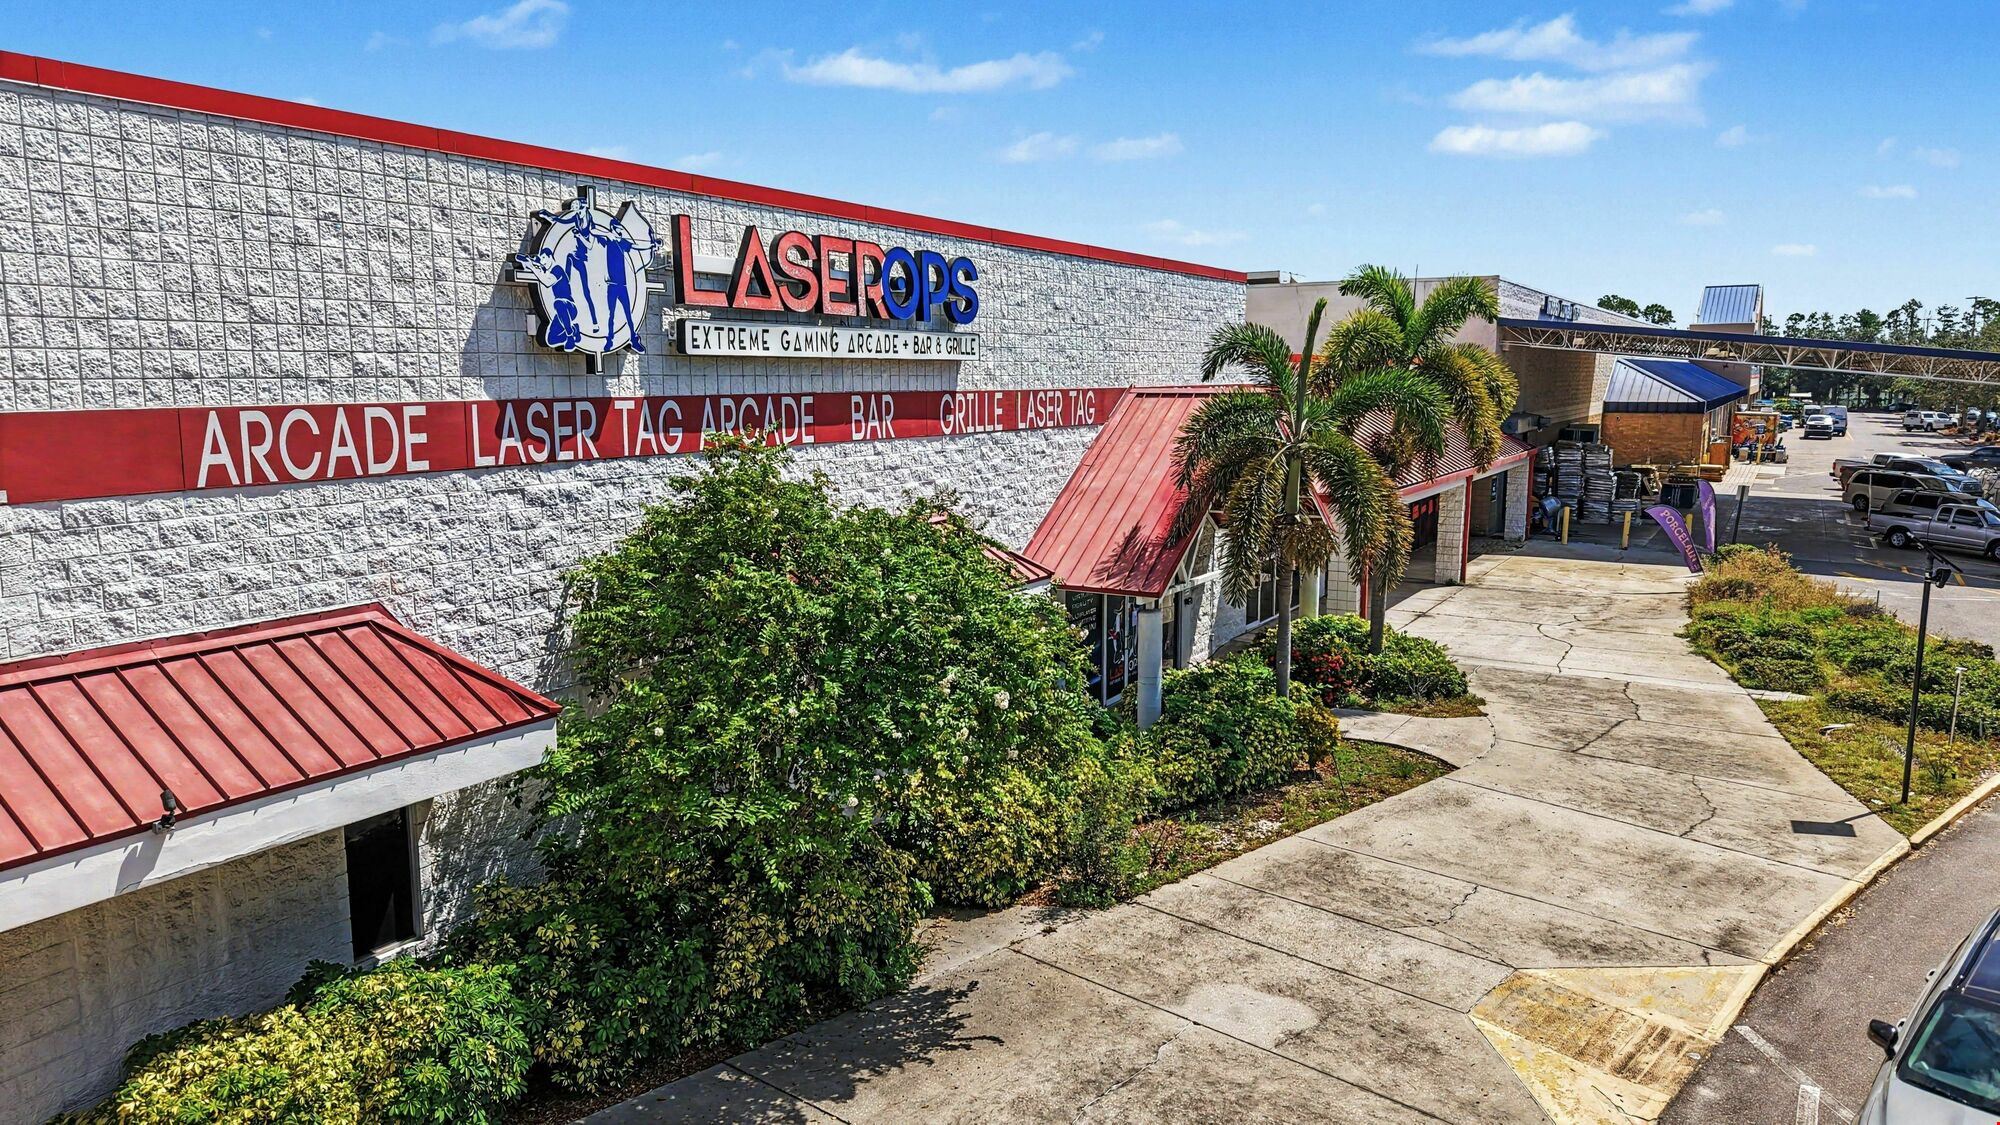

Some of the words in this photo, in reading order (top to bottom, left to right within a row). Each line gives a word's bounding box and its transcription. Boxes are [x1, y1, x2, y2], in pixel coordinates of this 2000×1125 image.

[691, 325, 770, 351] EXTREME
[780, 329, 839, 353] GAMING
[848, 332, 899, 354] ARCADE
[913, 335, 932, 355] BAR
[936, 337, 942, 354] &
[945, 337, 976, 355] GRILLE
[471, 401, 600, 467] LASER
[614, 399, 684, 456] TAG
[699, 395, 815, 451] ARCADE
[851, 394, 895, 441] BAR
[940, 392, 1004, 435] GRILLE
[1017, 390, 1064, 429] LASER
[1068, 390, 1096, 425] TAG
[197, 405, 431, 488] ARCADE
[1660, 510, 1697, 562] PORCELAIN
